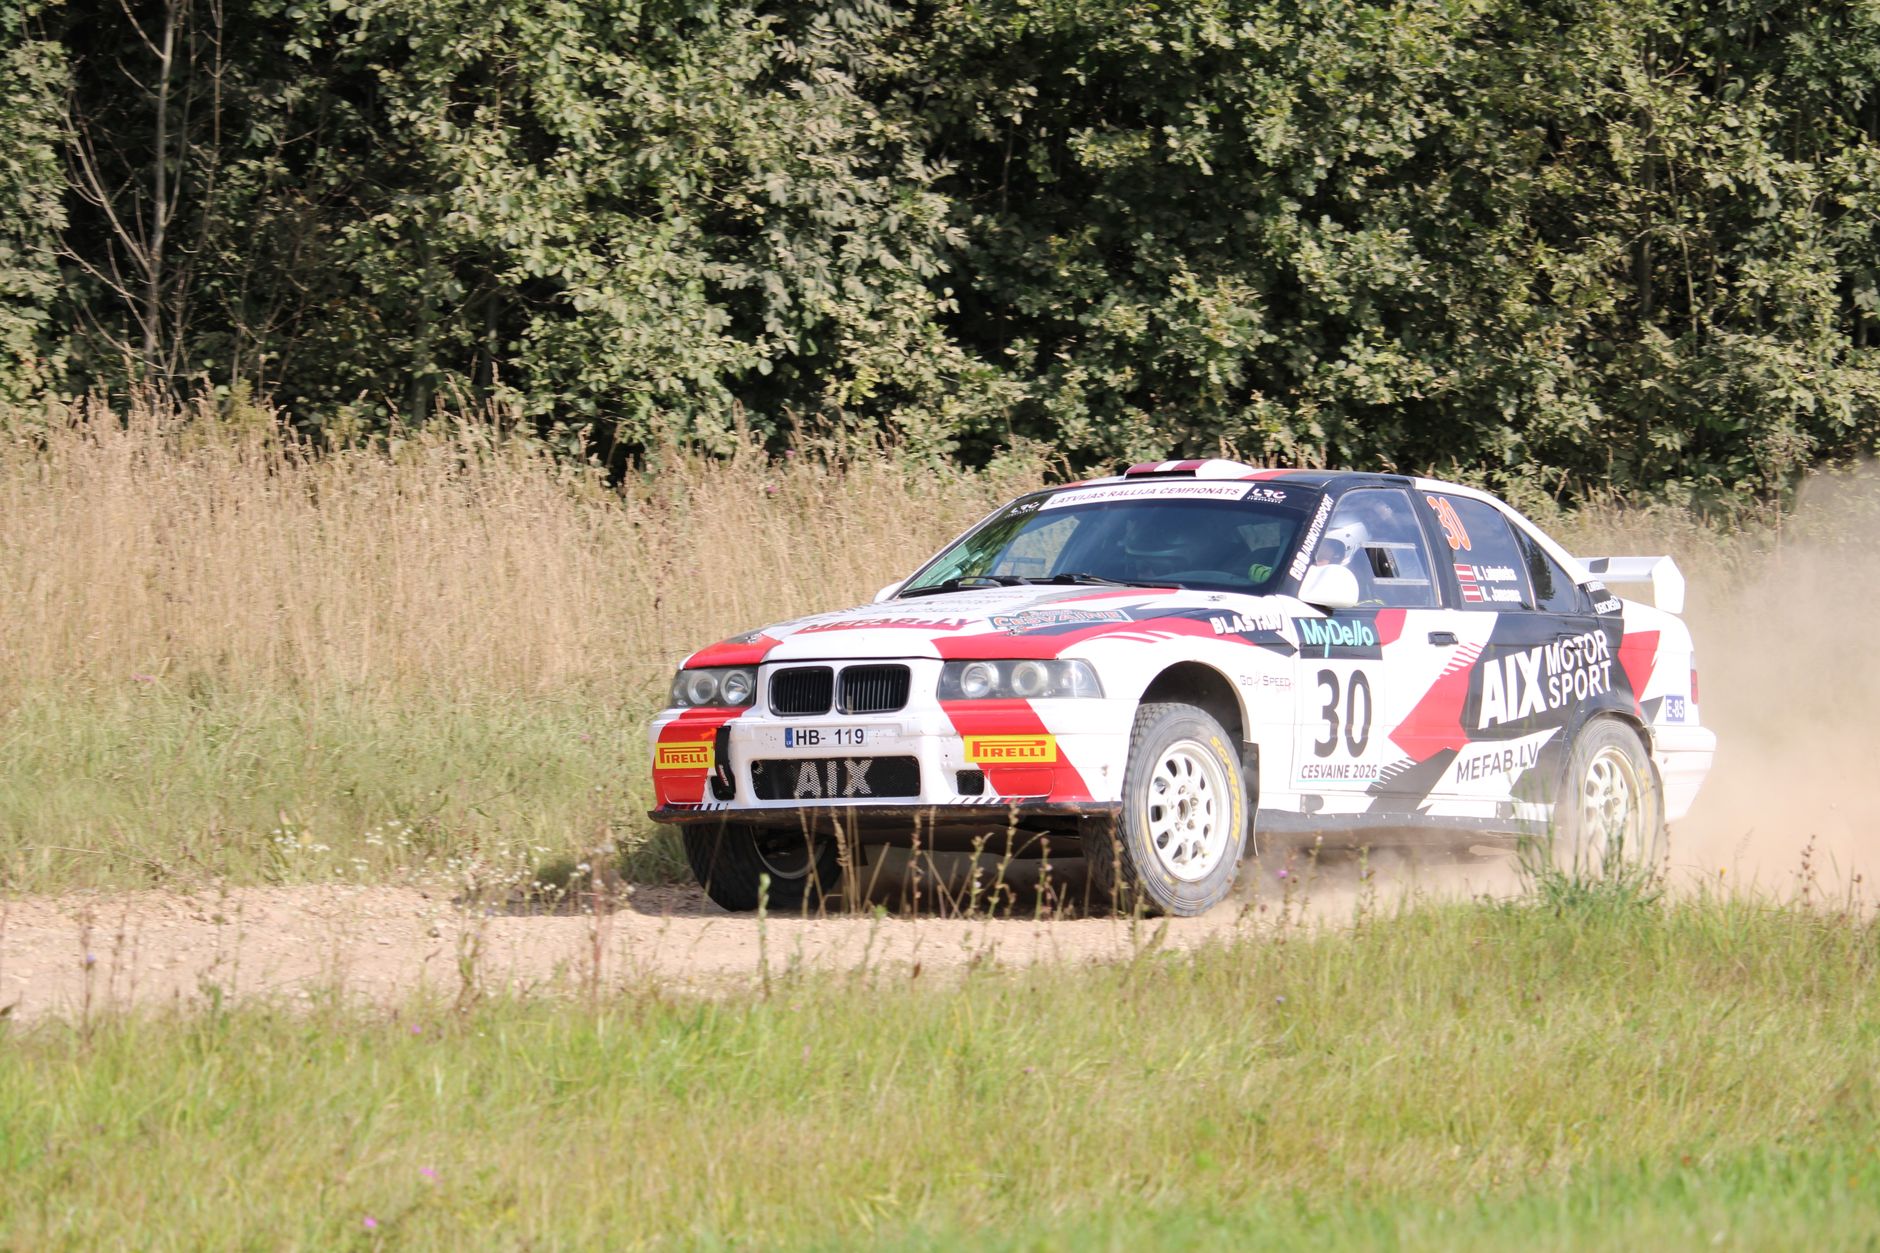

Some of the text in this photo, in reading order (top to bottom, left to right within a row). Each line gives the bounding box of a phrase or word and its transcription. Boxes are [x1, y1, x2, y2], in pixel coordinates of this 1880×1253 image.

[1107, 488, 1156, 497] RALLIJA
[1426, 495, 1472, 551] 30
[1300, 619, 1375, 658] MyDello
[1545, 629, 1610, 676] MOTOR
[1478, 646, 1547, 730] AIX
[1548, 659, 1611, 709] SPORT
[1313, 668, 1372, 758] 30
[1666, 696, 1685, 718] E-85
[659, 746, 708, 764] PIRELLI
[835, 728, 864, 745] 119
[972, 740, 1047, 758] PIRELLI
[793, 760, 873, 798] AIX
[1301, 764, 1378, 779] CESVAINE 2026
[1456, 740, 1539, 784] MEFAB.LV
